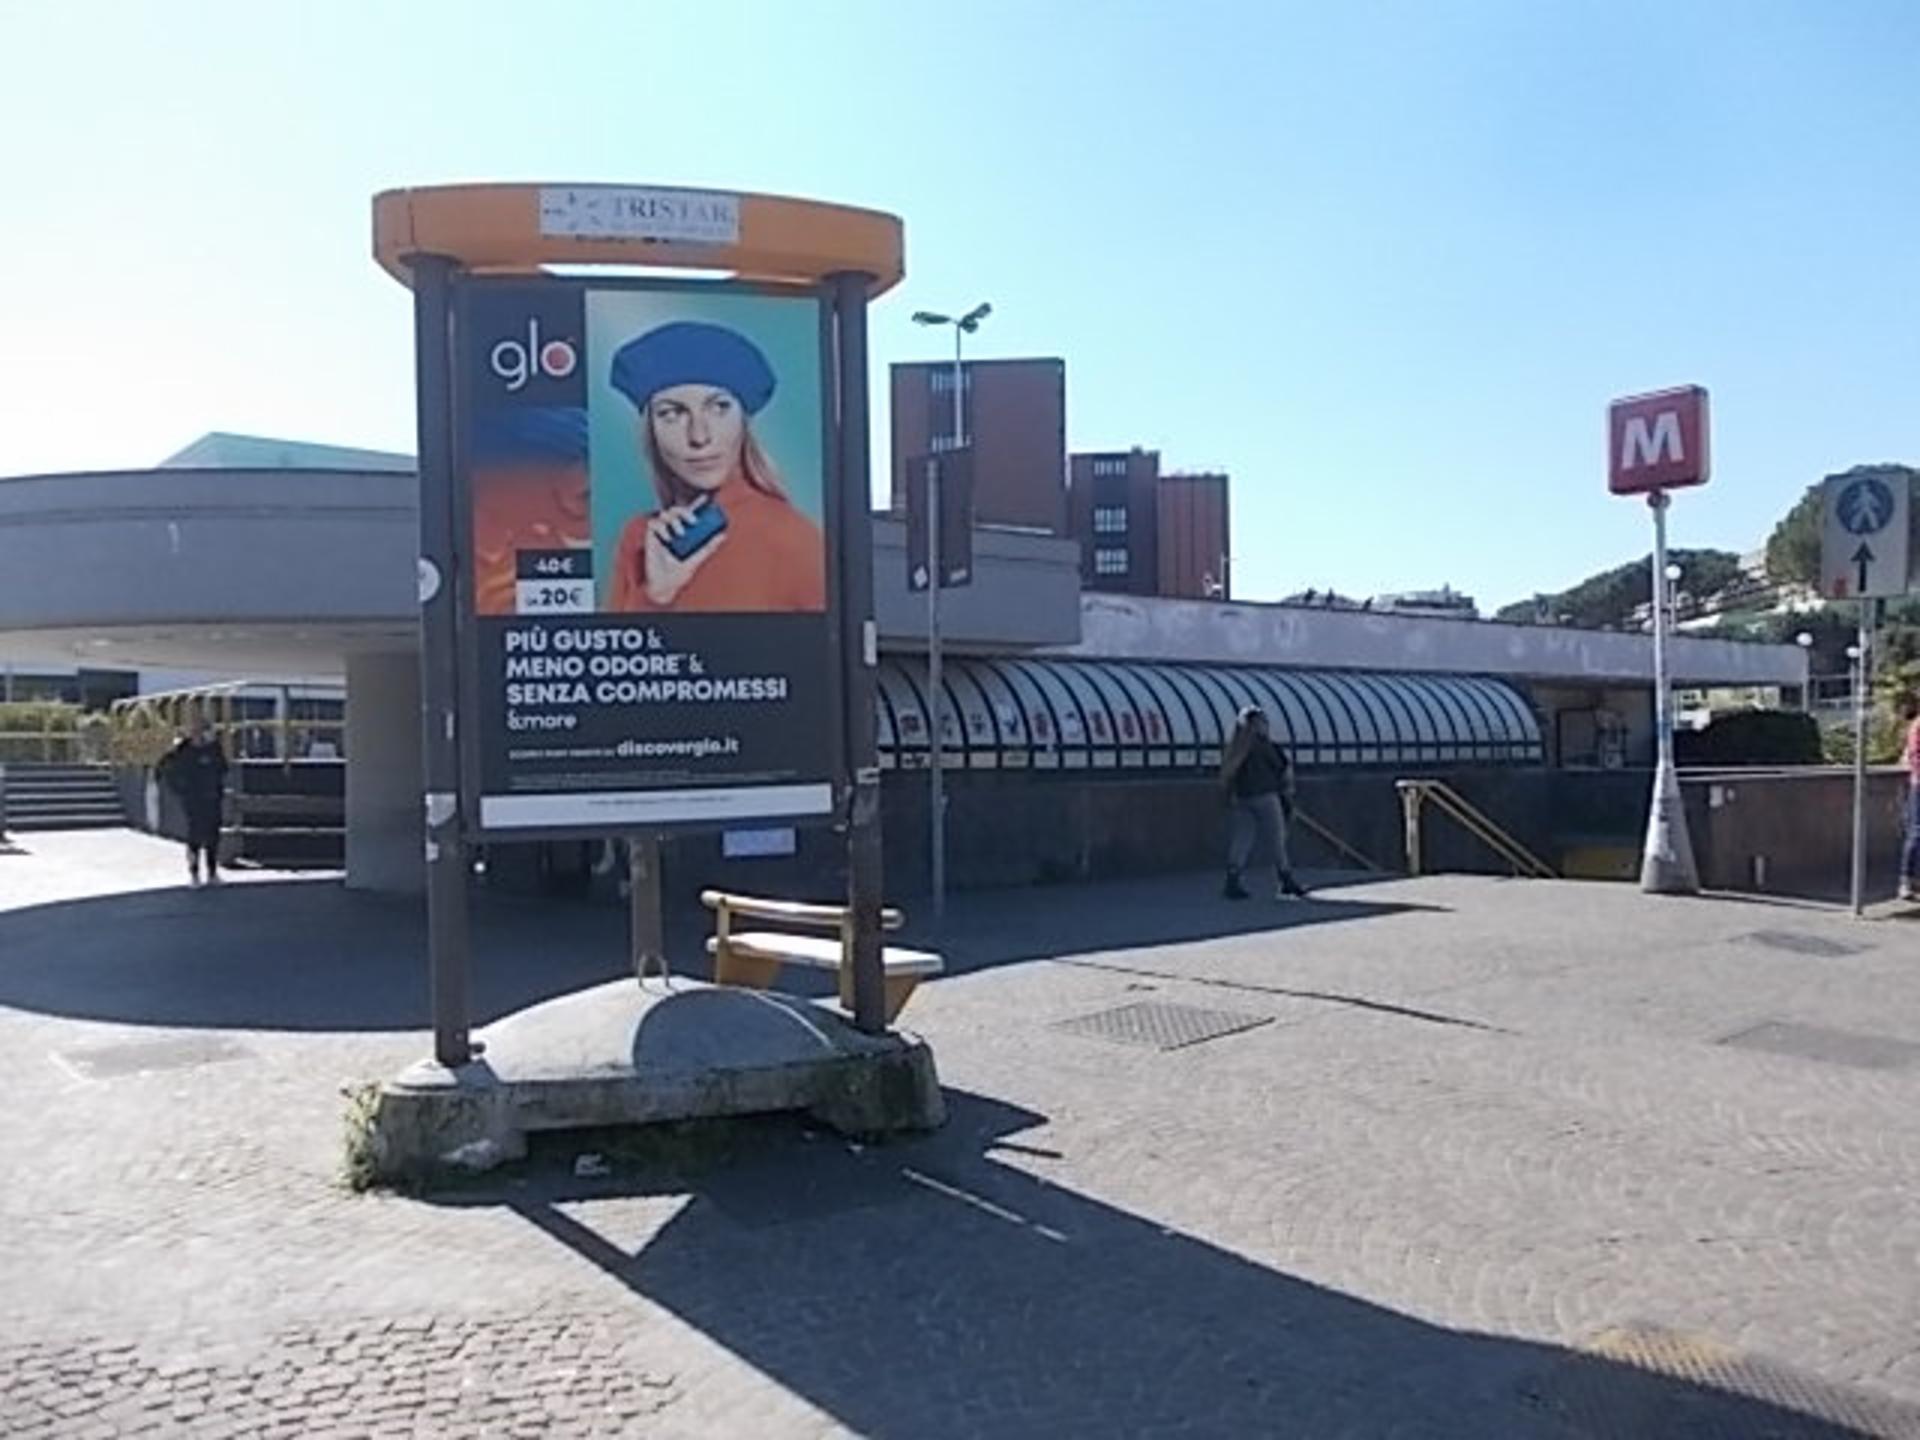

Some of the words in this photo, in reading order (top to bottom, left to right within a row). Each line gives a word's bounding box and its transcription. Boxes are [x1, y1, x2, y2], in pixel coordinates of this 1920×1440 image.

[611, 196, 728, 223] TRISTAR
[491, 318, 576, 391] glo
[1621, 411, 1684, 470] M
[506, 626, 547, 651] PIÙ
[553, 629, 644, 650] GUSTO
[647, 629, 662, 649] &
[506, 656, 585, 678] MENO
[689, 653, 704, 673] &
[506, 682, 591, 705] SENZA
[596, 677, 788, 703] COMPROMESSI
